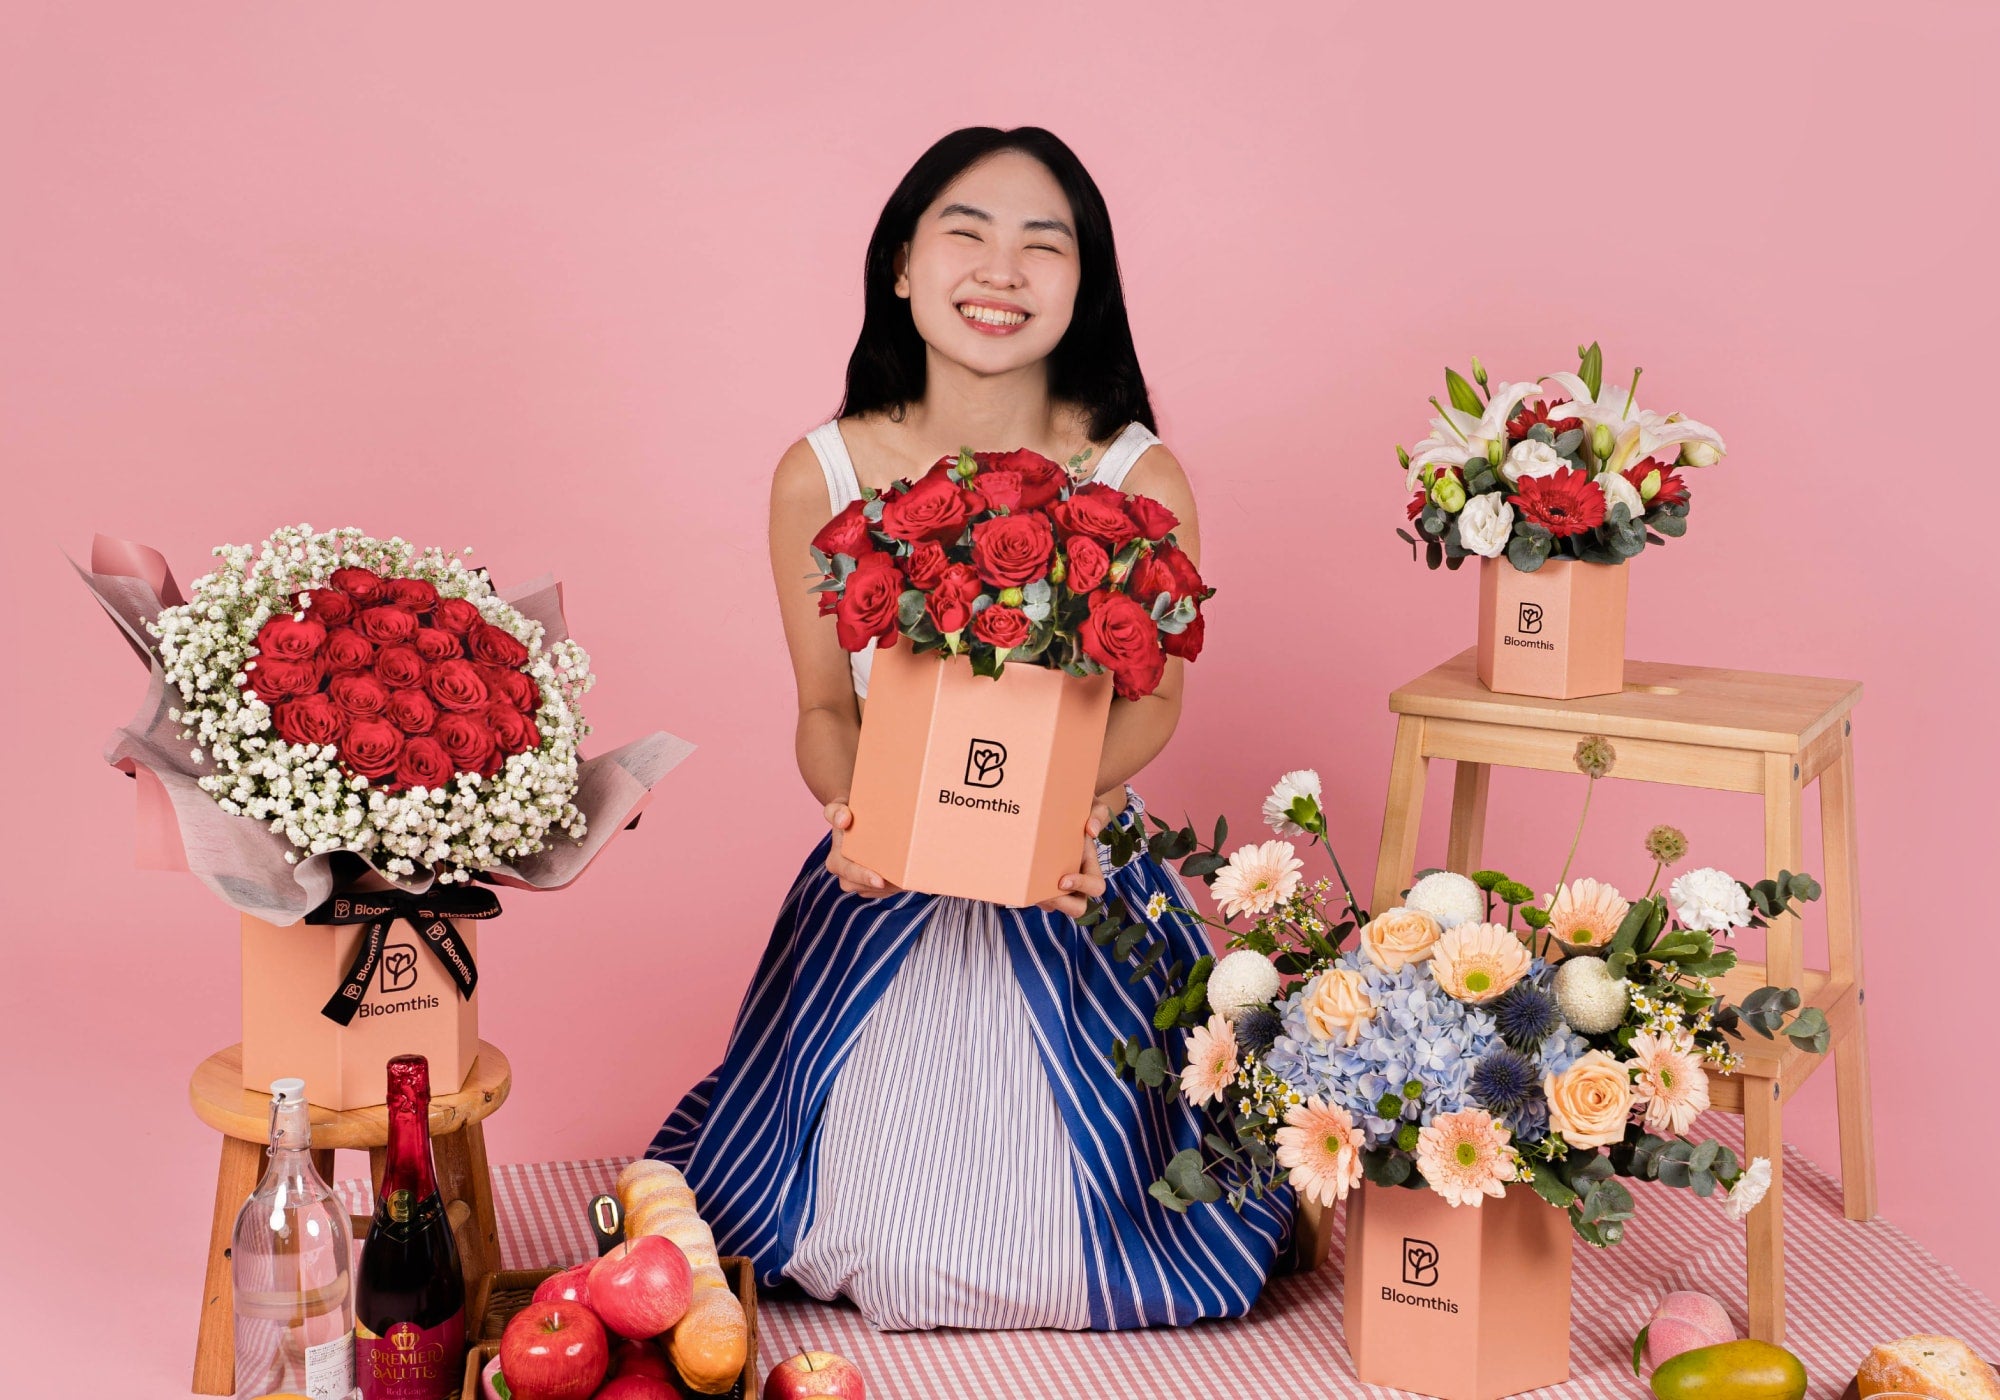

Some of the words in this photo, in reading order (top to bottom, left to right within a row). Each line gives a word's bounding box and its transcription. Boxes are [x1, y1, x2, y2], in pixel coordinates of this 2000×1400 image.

[1504, 635, 1554, 651] Bloomthis
[938, 789, 1020, 815] Bloomthis
[356, 923, 381, 981] Bloomthis
[441, 937, 472, 985] Bloomthis
[359, 994, 439, 1018] Bloomthis
[1381, 1286, 1459, 1314] Bloomthis
[370, 1343, 444, 1367] PREMIER
[373, 1364, 437, 1384] SALUTE
